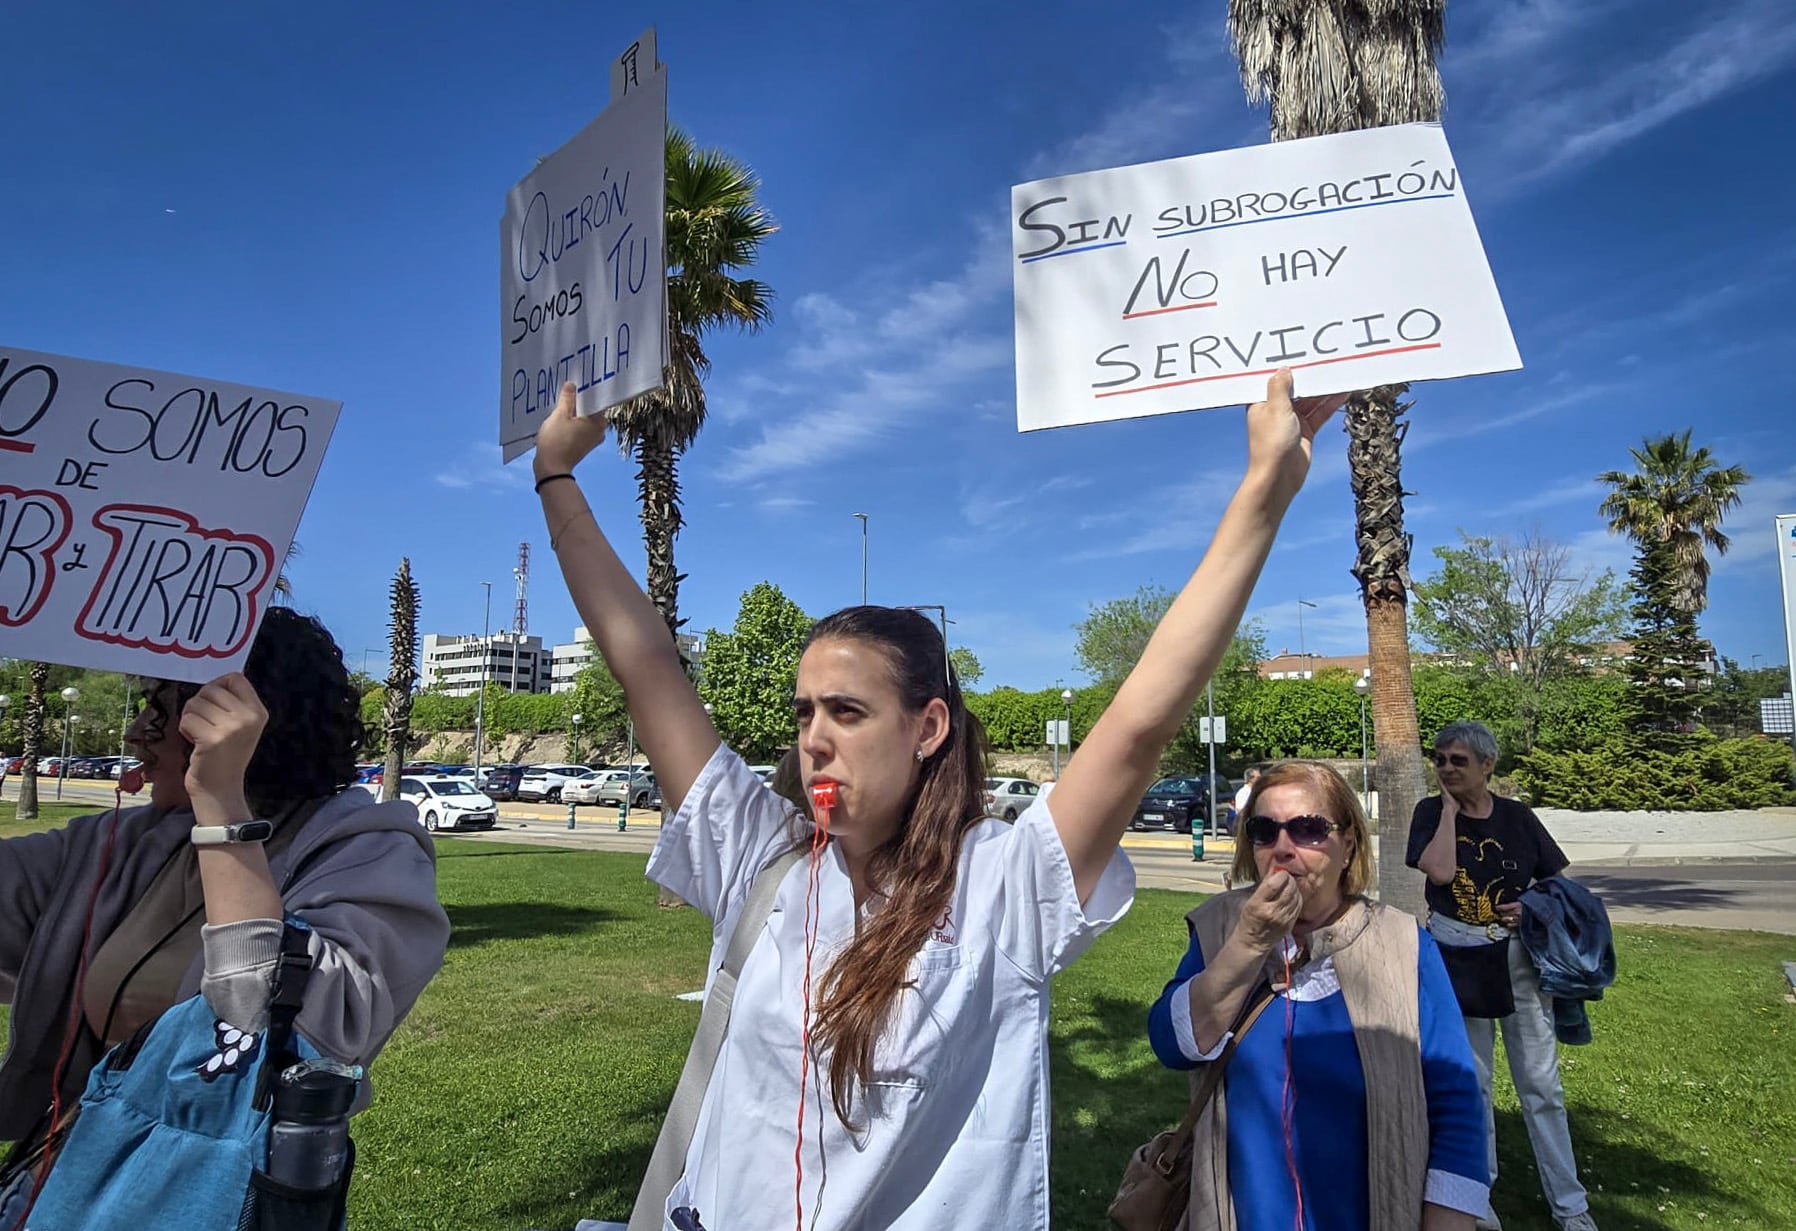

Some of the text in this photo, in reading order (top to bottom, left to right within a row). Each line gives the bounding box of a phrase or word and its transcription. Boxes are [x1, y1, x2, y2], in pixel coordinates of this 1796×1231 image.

[1152, 160, 1456, 231] SUBROGACIÓN
[511, 222, 647, 344] SOMOS TU
[1261, 246, 1348, 287] HAY
[512, 322, 630, 424] PLANTILLA
[1091, 308, 1442, 389] SERVICIO
[0, 358, 309, 478] O SOMOS
[55, 458, 109, 490] DE
[0, 499, 55, 617] R
[95, 514, 258, 646] TIRAR
